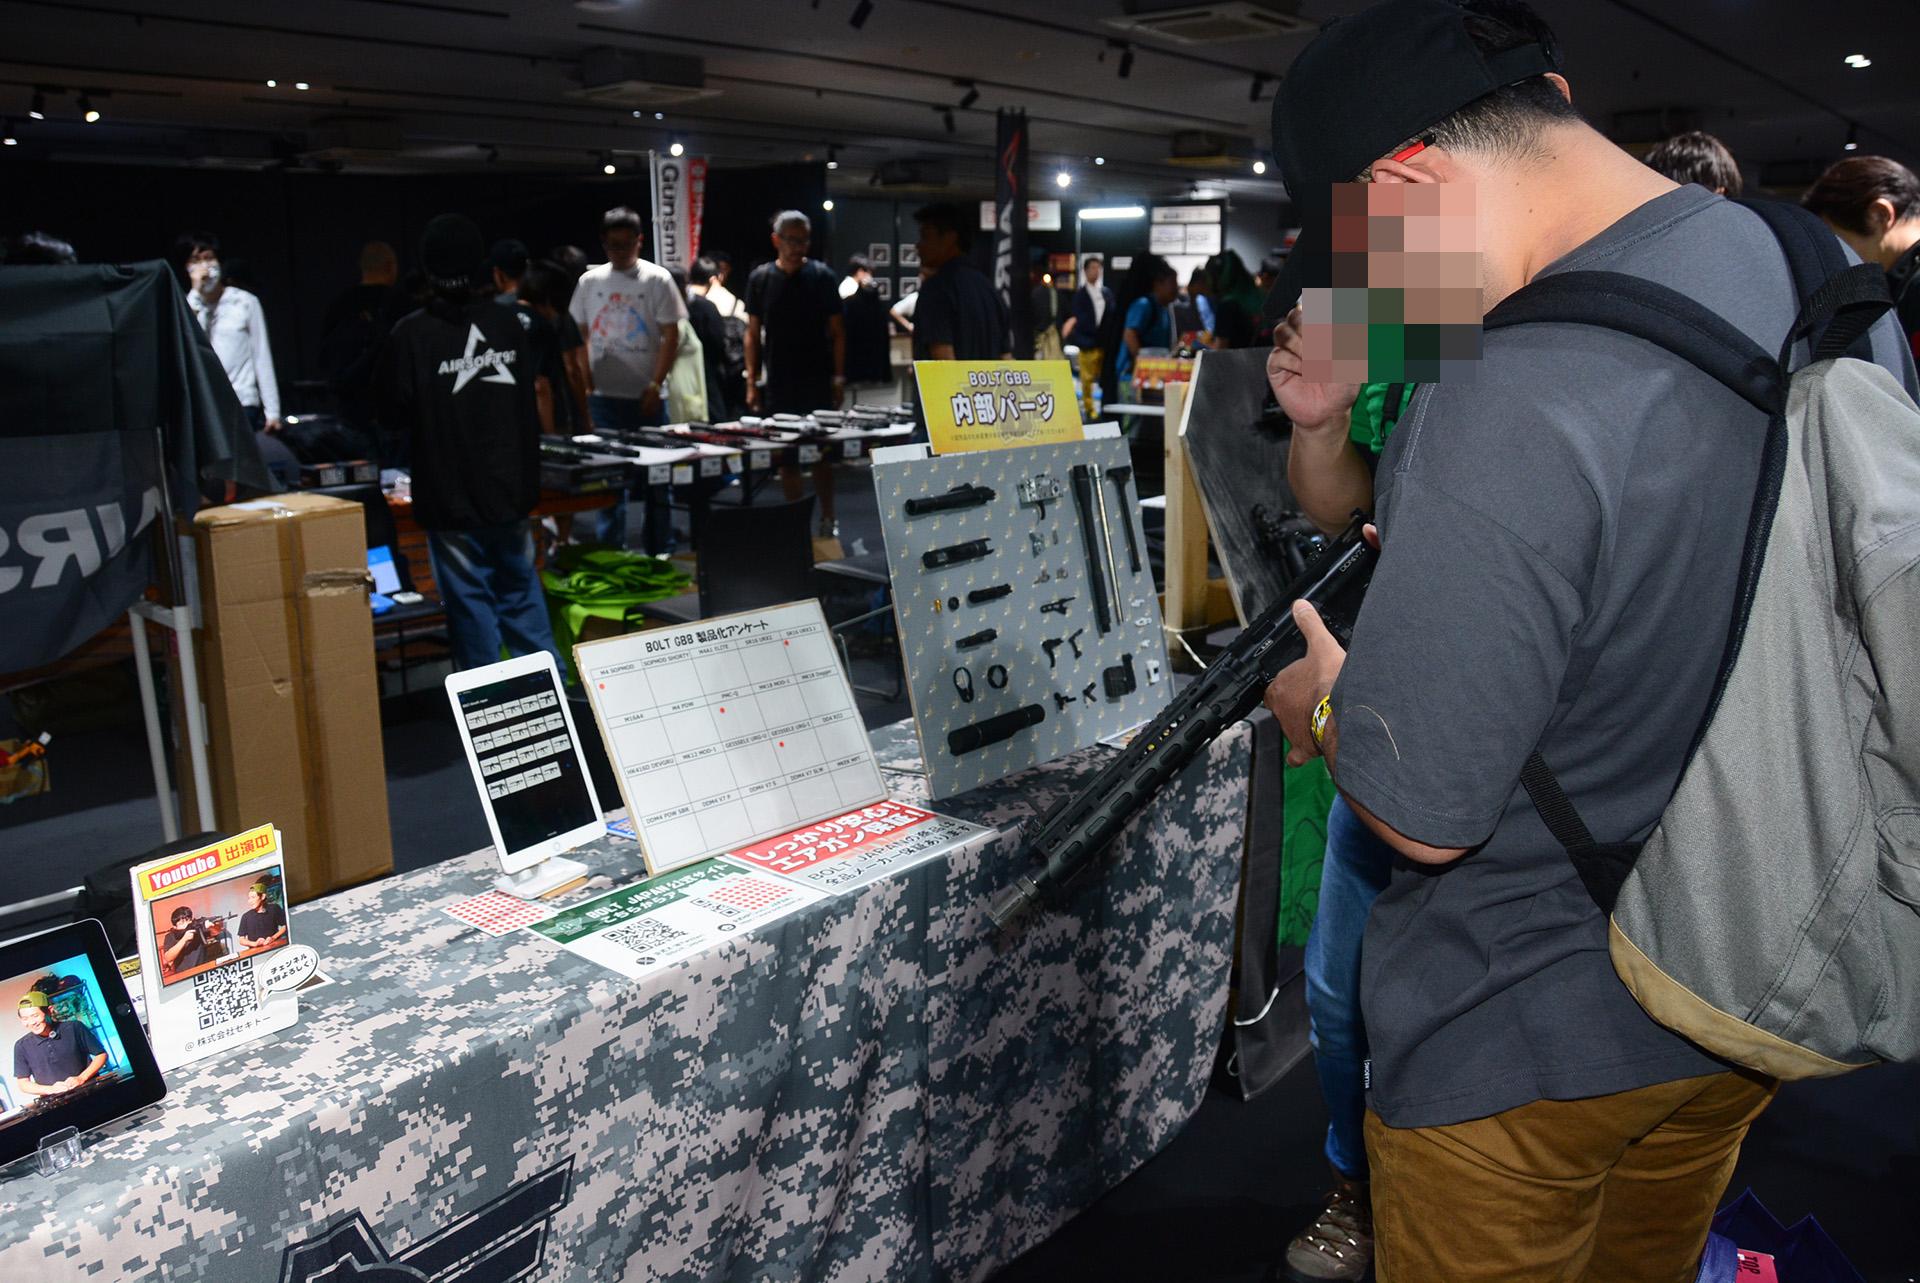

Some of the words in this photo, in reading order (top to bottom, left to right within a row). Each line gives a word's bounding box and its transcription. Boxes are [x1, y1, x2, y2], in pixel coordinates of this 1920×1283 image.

[968, 371, 1000, 386] BOLT
[1005, 371, 1031, 385] GBB
[951, 391, 1054, 427] 内部パーツ
[646, 638, 671, 652] BOLT
[674, 634, 694, 647] GBB
[696, 620, 768, 643] 製品化アンケート
[644, 658, 666, 666] SOPMOD
[668, 653, 689, 662] SHORTY
[610, 664, 634, 673] SOPMOD
[624, 714, 644, 722] M16A4
[771, 726, 795, 736] GEISSELE
[725, 738, 749, 748] GEISSELE
[627, 765, 650, 774] HK416D
[651, 759, 674, 768] DEVGRU
[646, 815, 663, 824] DDM4
[152, 854, 216, 891] Youtube
[225, 834, 269, 862] 出演中
[808, 860, 853, 881] BOLT
[585, 902, 623, 919] BOLT
[628, 864, 728, 905] JAPAN公式サイト
[185, 1041, 194, 1052] @
[197, 1015, 271, 1047] 株式会社セキトー
[1742, 1256, 1760, 1274] TOP
